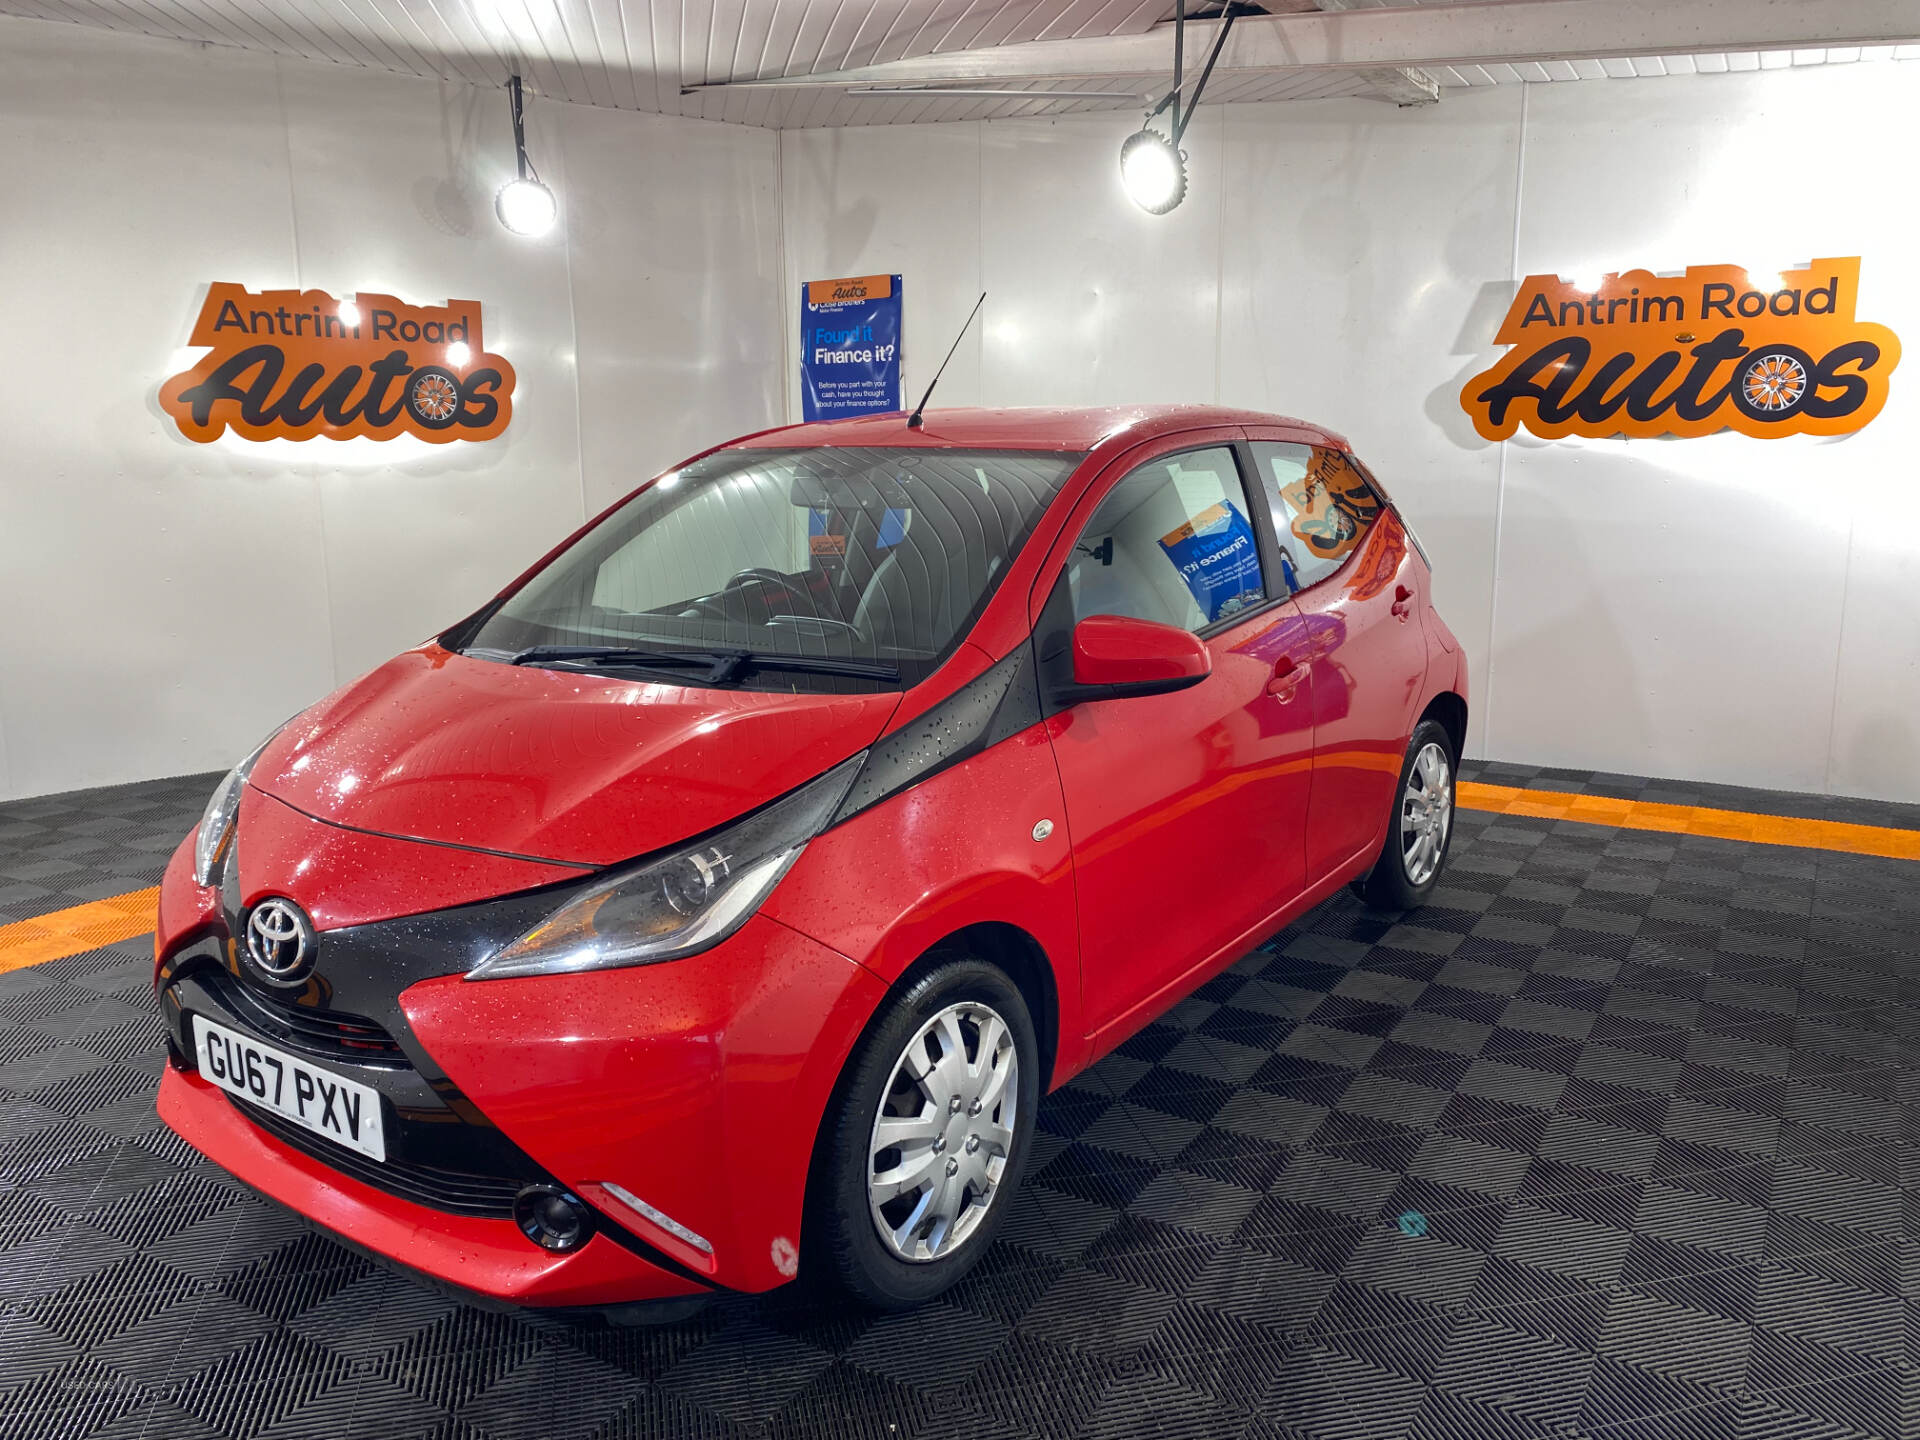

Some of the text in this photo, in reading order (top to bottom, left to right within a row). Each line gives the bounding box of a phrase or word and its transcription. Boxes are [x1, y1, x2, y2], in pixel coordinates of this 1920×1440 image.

[832, 286, 867, 299] Autos
[1520, 276, 1838, 328] Antrim Road
[213, 300, 468, 344] Antrim Road
[815, 326, 873, 344] Found it
[815, 345, 895, 364] Finance it?
[1477, 328, 1880, 426] Autos
[177, 344, 502, 430] Autos
[206, 1031, 283, 1106] GU67
[294, 1068, 361, 1142] PXV
